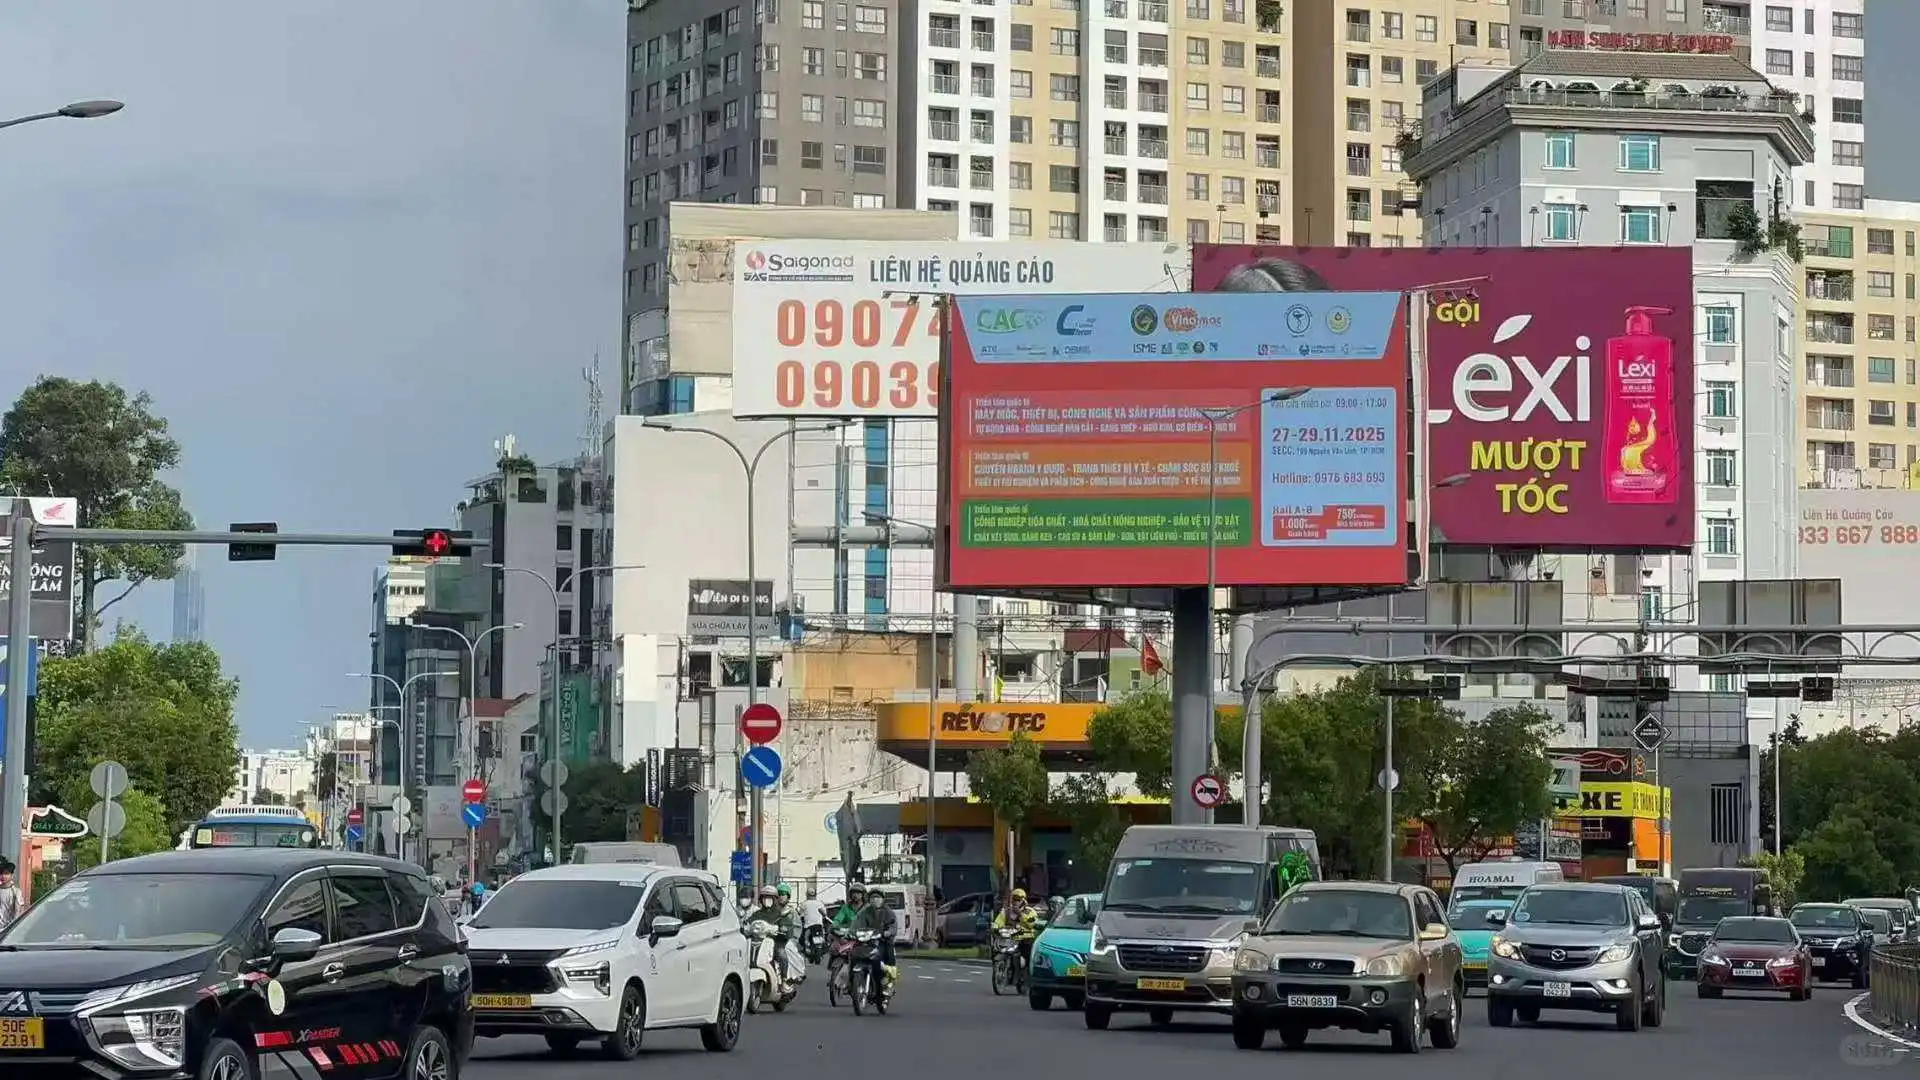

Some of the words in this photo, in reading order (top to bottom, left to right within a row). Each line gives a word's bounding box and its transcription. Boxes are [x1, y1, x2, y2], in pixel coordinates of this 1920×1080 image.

[768, 253, 854, 271] Saigonad
[870, 254, 911, 283] LIÊN
[918, 254, 941, 288] HỆ
[949, 251, 1010, 284] QUẢNG
[1017, 253, 1054, 283] CÁO
[1436, 299, 1480, 327] GỘI
[1471, 436, 1586, 478] MƯỢT
[1495, 477, 1569, 513] TÓC
[1836, 525, 1873, 544] 667
[1581, 791, 1622, 810] XE
